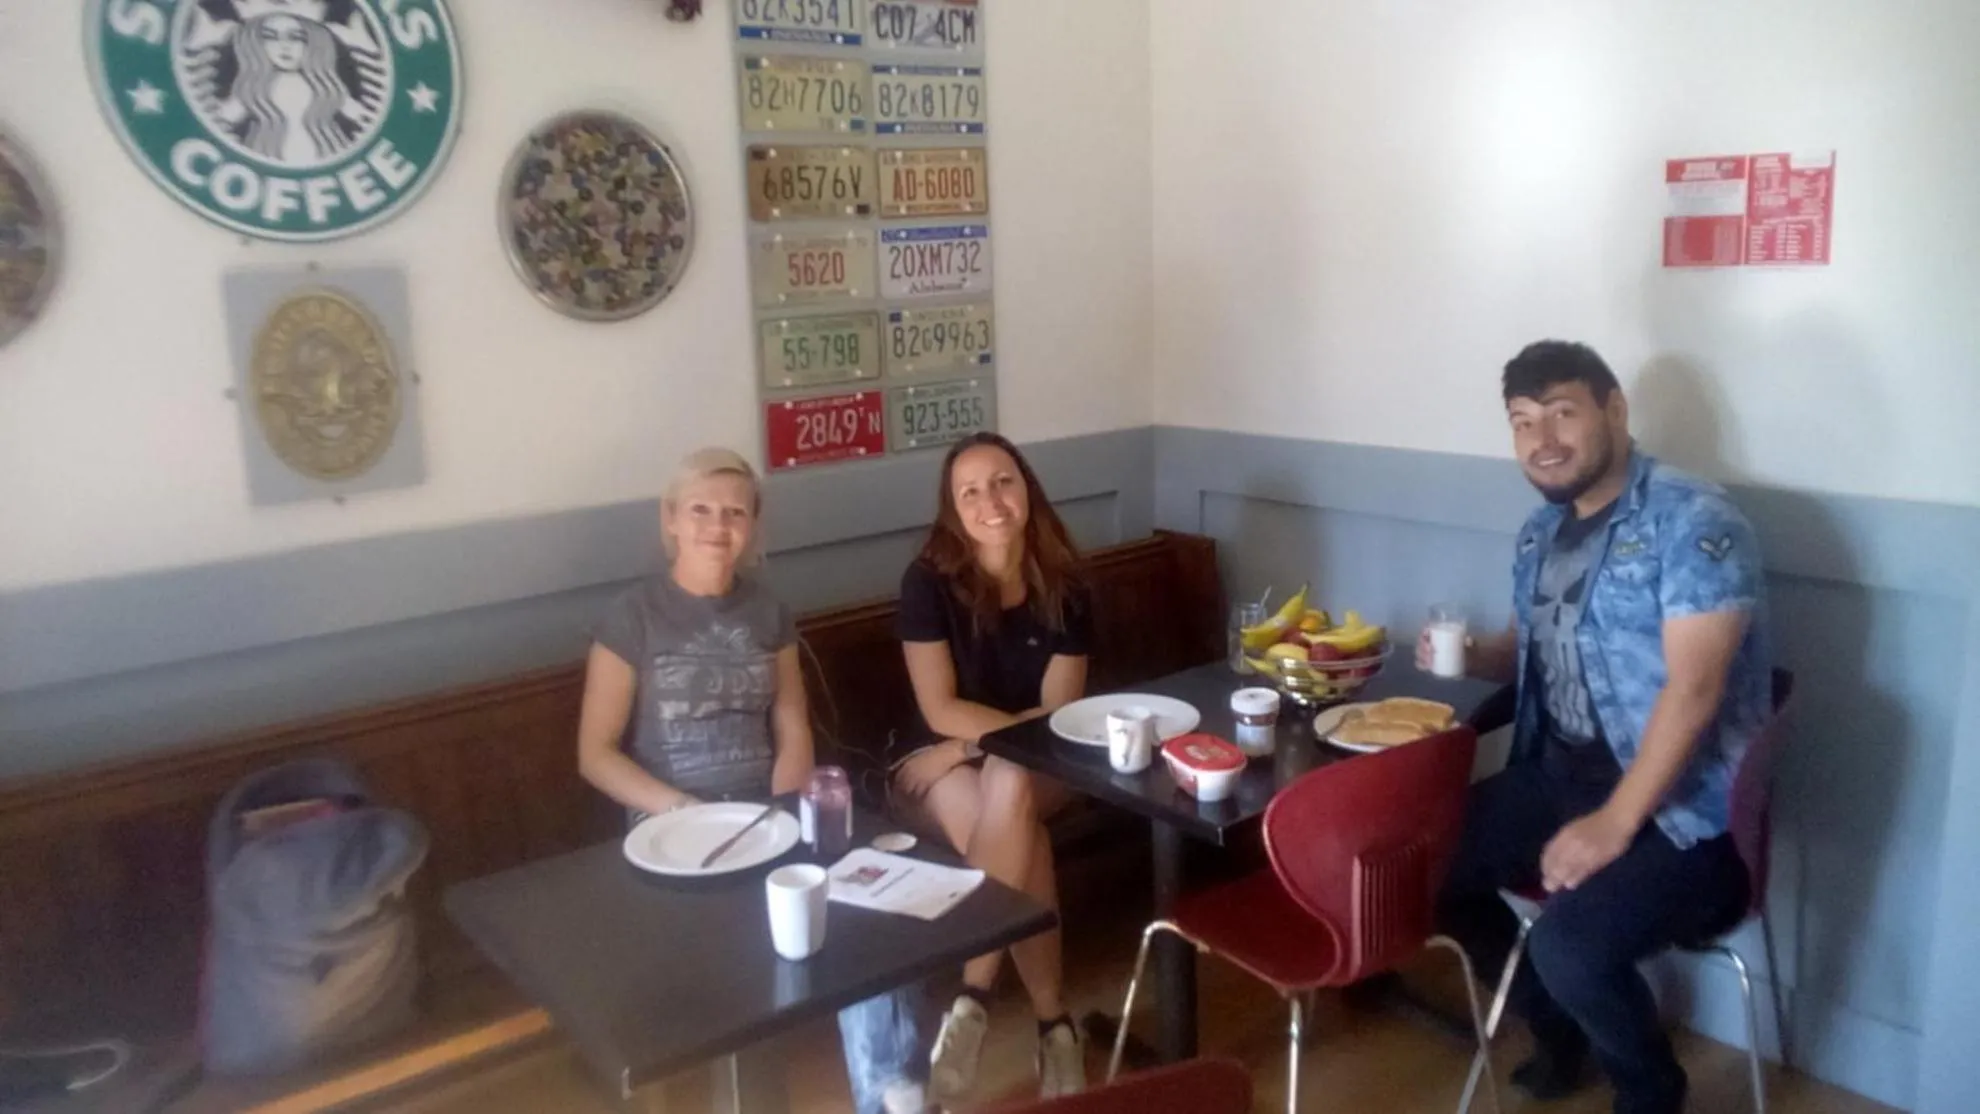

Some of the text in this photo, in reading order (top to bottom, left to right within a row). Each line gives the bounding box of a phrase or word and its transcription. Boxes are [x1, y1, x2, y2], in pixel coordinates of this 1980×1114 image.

[875, 3, 917, 40] C07
[169, 136, 418, 224] COFFEE
[762, 164, 862, 202] 68576V
[893, 166, 975, 202] AD-6080
[787, 250, 845, 287] 5620
[889, 240, 982, 279] 20XM732
[782, 332, 860, 372] 55-798
[795, 407, 858, 451] 2849
[903, 395, 984, 436] 923-555
